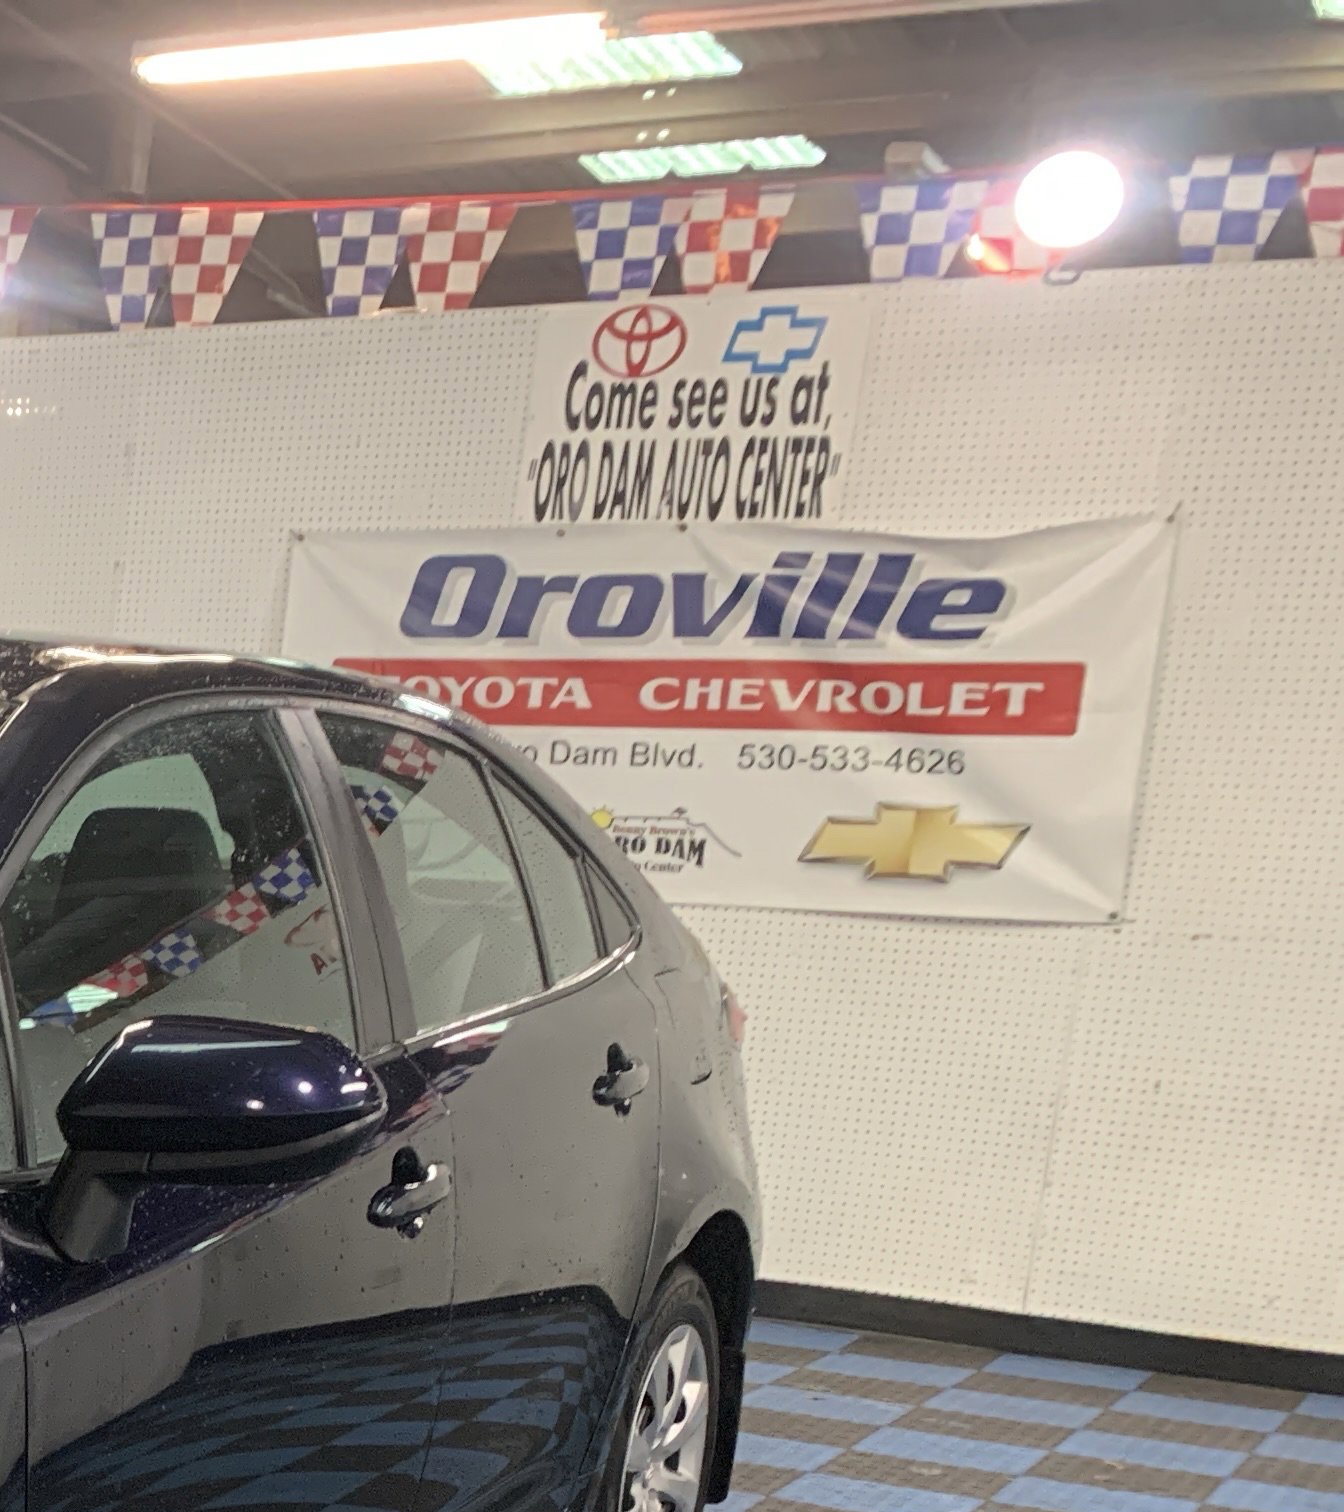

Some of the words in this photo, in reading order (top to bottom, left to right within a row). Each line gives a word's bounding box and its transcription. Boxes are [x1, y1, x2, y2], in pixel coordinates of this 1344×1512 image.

[565, 359, 659, 431] Come
[668, 377, 729, 430] see
[740, 375, 780, 428] us
[791, 360, 832, 431] at,
[528, 439, 591, 523] "ORO
[593, 439, 658, 520] DAM
[657, 436, 731, 523] AUTO
[736, 435, 843, 520] CENTER"
[399, 551, 1012, 643] Oroville
[380, 676, 593, 710] OYOTA
[640, 677, 1045, 717] CHEVROLET
[550, 739, 617, 766] Dam
[630, 741, 705, 770] Blvd.
[737, 743, 966, 776] 530-533-4626
[644, 861, 684, 873] Center
[655, 837, 707, 868] DAM
